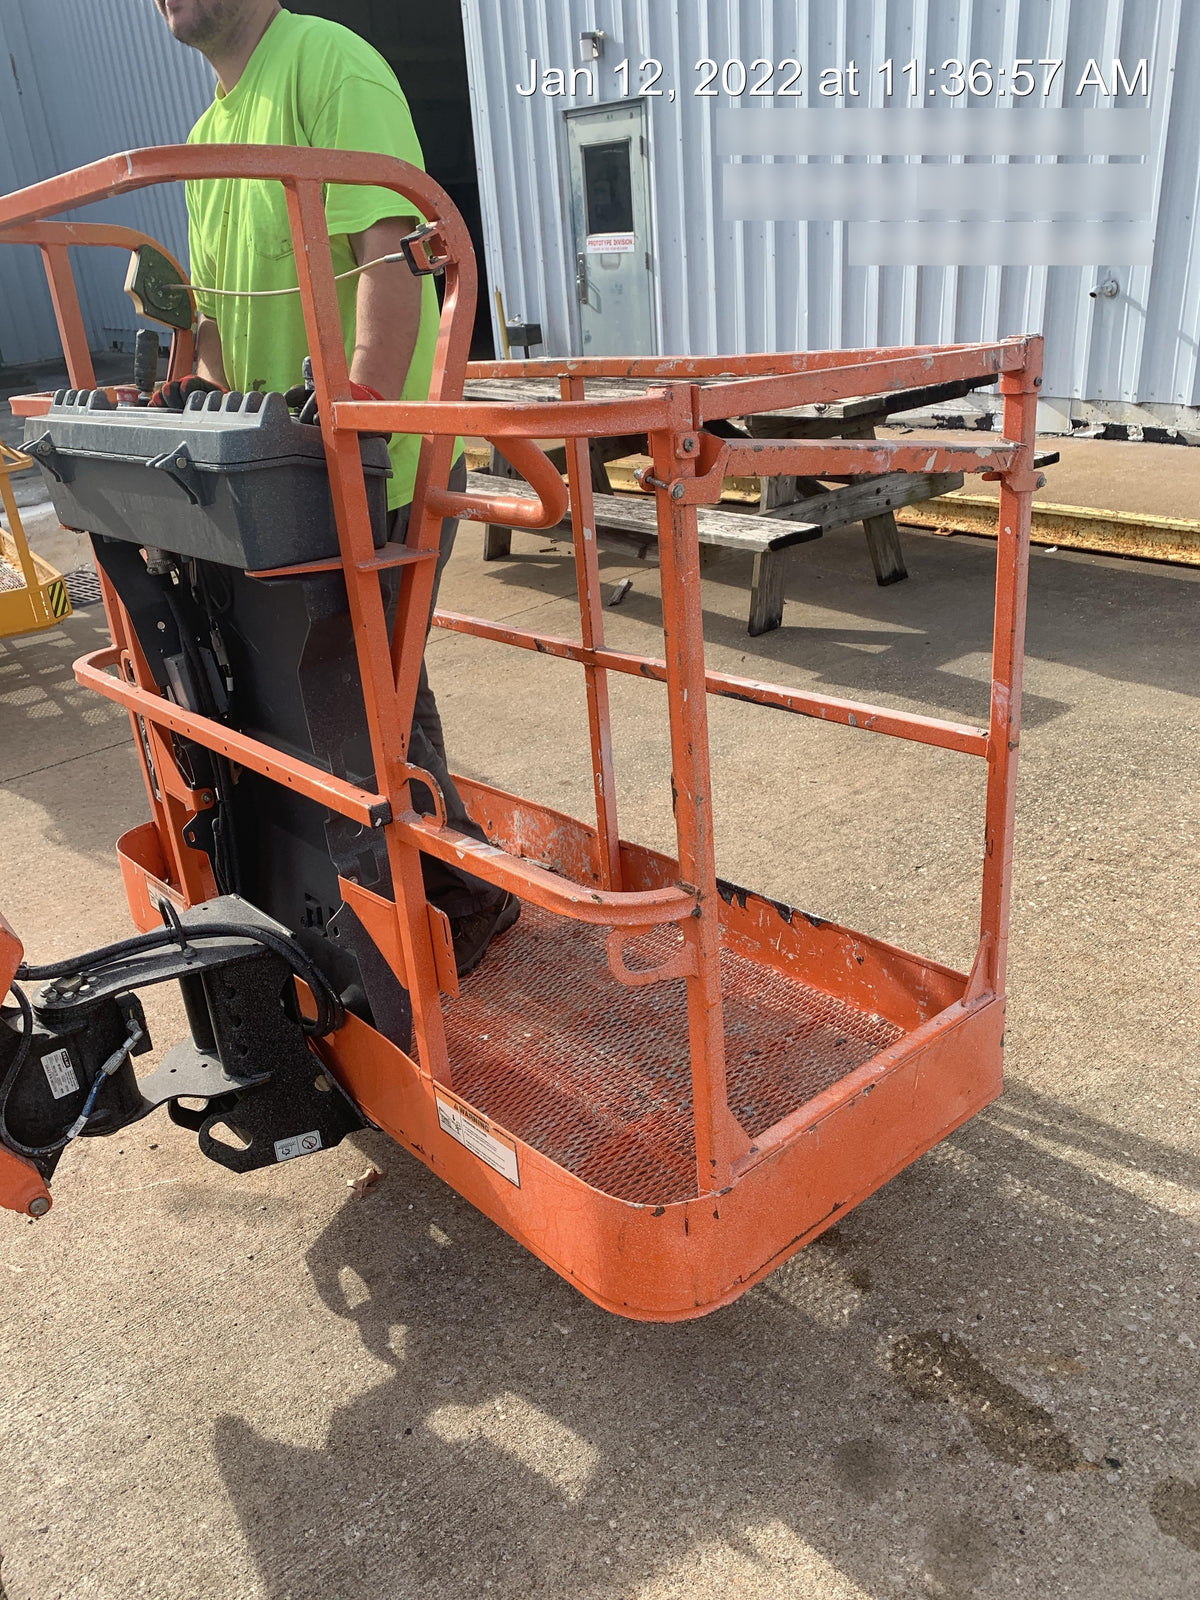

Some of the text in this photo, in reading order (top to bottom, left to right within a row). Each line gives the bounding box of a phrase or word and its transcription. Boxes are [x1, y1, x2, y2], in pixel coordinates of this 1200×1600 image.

[588, 238, 633, 247] PROTOTYPE DIVISION
[459, 1107, 490, 1132] WARNING
